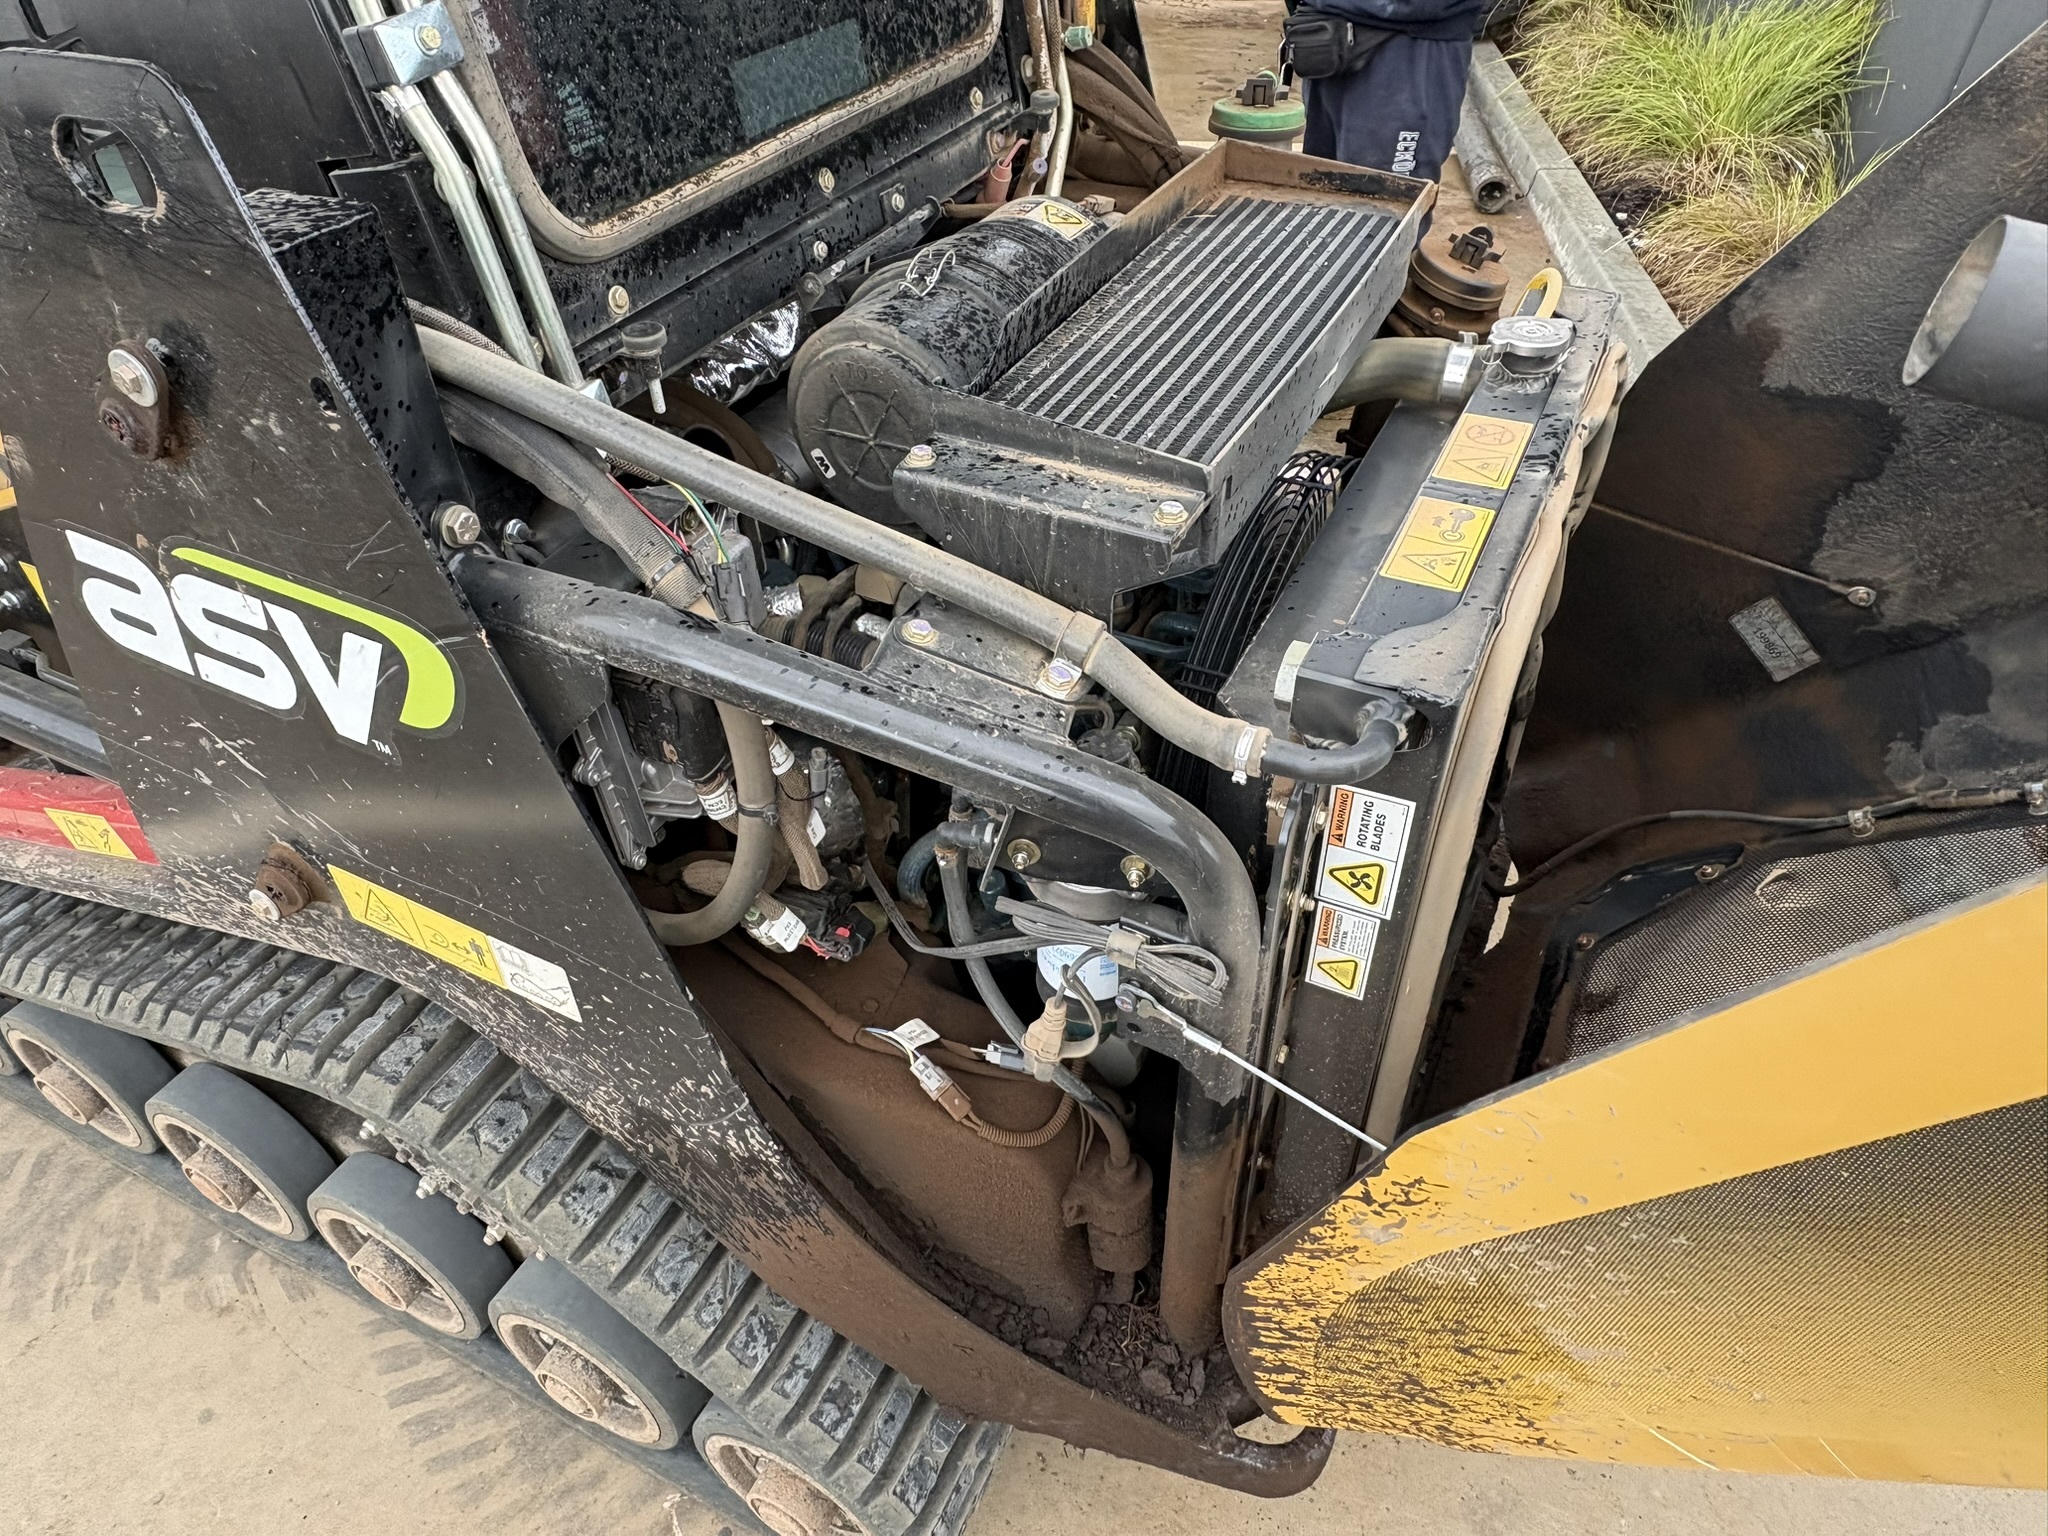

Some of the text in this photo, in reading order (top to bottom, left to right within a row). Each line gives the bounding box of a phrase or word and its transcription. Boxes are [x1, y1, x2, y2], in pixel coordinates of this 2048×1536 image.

[1335, 792, 1349, 831] WARNING
[1356, 800, 1374, 848] ROTATING
[1370, 813, 1387, 852] BLADES
[1322, 909, 1333, 936] WARNING
